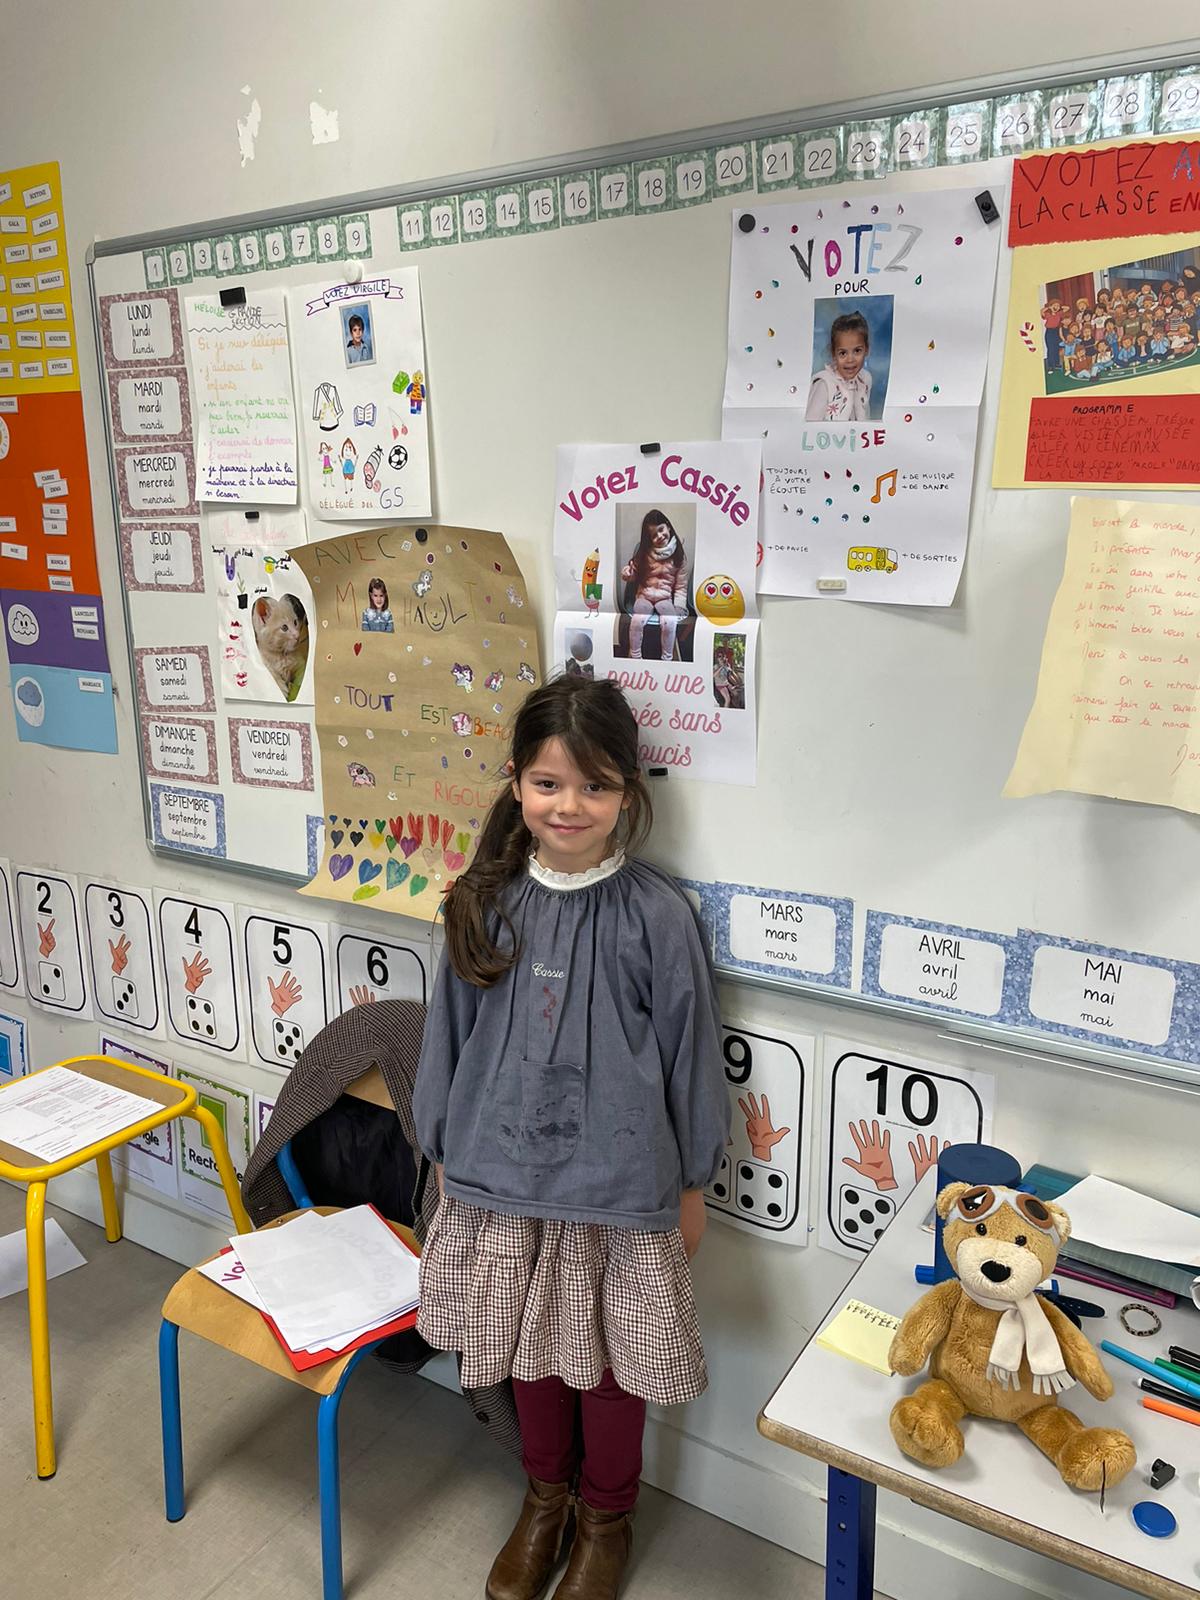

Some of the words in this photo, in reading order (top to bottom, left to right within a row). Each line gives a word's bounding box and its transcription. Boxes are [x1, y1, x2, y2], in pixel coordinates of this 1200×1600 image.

[1109, 92, 1139, 118] 28
[1168, 89, 1199, 112] 29
[1001, 112, 1029, 138] 26
[1054, 103, 1085, 130] 27
[900, 131, 924, 154] 24
[950, 123, 977, 148] 25
[808, 148, 832, 172] 22
[851, 141, 877, 164] 23
[719, 156, 744, 179] 20
[766, 151, 788, 175] 21
[1019, 145, 1157, 192] VOTEZ
[645, 178, 663, 198] 18
[683, 169, 702, 190] 19
[570, 190, 587, 210] 16
[607, 181, 625, 202] 17
[501, 202, 517, 221] 14
[534, 196, 551, 217] 15
[435, 213, 451, 232] 12
[468, 207, 484, 226] 13
[407, 220, 420, 236] 11
[297, 235, 305, 250] 7
[324, 232, 332, 248] 8
[352, 230, 361, 246] 9
[200, 249, 206, 264] 3
[222, 250, 230, 263] 4
[246, 244, 254, 259] 5
[272, 240, 280, 256] 6
[790, 223, 923, 282] VOTEZ
[153, 263, 158, 276] 1
[176, 257, 183, 272] 2
[325, 286, 349, 300] VOTEZ
[353, 280, 387, 294] VIRGILE
[834, 278, 870, 295] POUR
[127, 304, 152, 321] LUNDI
[131, 323, 151, 337] lundi
[132, 339, 155, 354] lundi
[134, 381, 163, 396] MARDI
[138, 400, 162, 414] mardi
[140, 420, 164, 430] mardi
[133, 457, 177, 473] MERCREDI
[219, 463, 248, 480] pourrai
[250, 462, 274, 479] parler
[275, 462, 282, 472] à
[284, 462, 293, 473] la
[766, 467, 808, 476] TOUJOURS
[138, 475, 174, 488] mercredi
[257, 477, 265, 486] la
[559, 465, 639, 522] Votez
[660, 454, 750, 527] Cassie
[770, 482, 806, 495] ÉCOUTE
[142, 495, 176, 505] mercredi
[380, 486, 404, 509] GS
[150, 532, 172, 546] JEUDI
[152, 549, 171, 564] jeudi
[314, 534, 397, 567] AVEC
[154, 568, 174, 584] jeudi
[155, 657, 187, 671] SAMEDI
[160, 674, 187, 687] samedi
[607, 669, 658, 692] pour
[664, 673, 706, 695] une
[163, 692, 189, 701] samedi
[344, 685, 394, 712] TOUT
[420, 704, 449, 726] EST
[669, 708, 723, 734] sans
[155, 725, 197, 742] DIMANCHE
[247, 729, 291, 746] VENDREDI
[160, 742, 195, 756] dimanche
[252, 749, 288, 762] vendredi
[638, 743, 693, 767] oucis
[161, 757, 195, 771] dimanche
[254, 765, 289, 777] vendredi
[394, 765, 416, 787] ET
[163, 793, 210, 813] SEPTEMBRE
[168, 811, 207, 827] septembre
[171, 825, 206, 843] septembre
[36, 881, 53, 914] 2
[107, 892, 124, 927] 3
[761, 901, 803, 923] MARS
[184, 907, 202, 944] 4
[765, 928, 798, 943] mars
[272, 926, 292, 965] 5
[919, 934, 965, 961] AVRIL
[765, 949, 798, 962] mars
[366, 945, 389, 986] 6
[532, 962, 565, 979] Cassie
[922, 965, 958, 980] avril
[1084, 958, 1122, 984] MAI
[918, 982, 958, 1001] avril
[1083, 986, 1115, 1006] mai
[1080, 1011, 1113, 1028] mai
[723, 1034, 752, 1084] 9
[866, 1064, 939, 1127] 10
